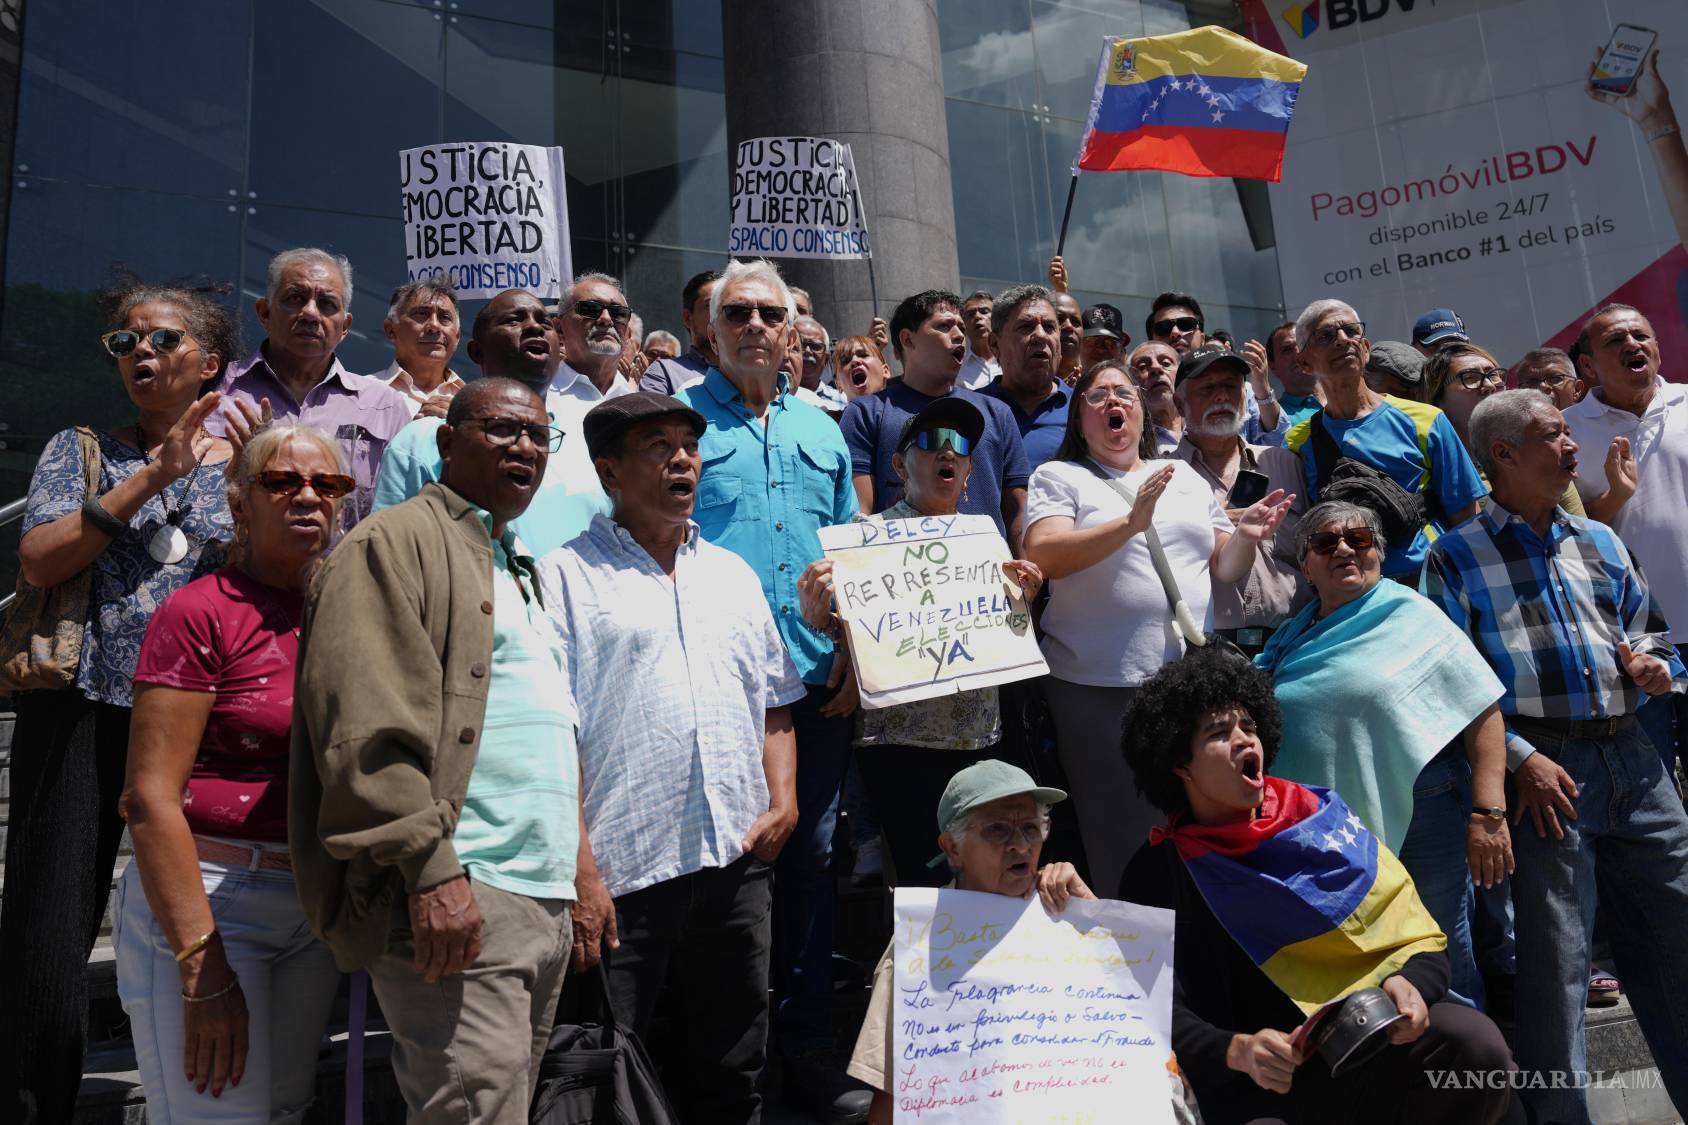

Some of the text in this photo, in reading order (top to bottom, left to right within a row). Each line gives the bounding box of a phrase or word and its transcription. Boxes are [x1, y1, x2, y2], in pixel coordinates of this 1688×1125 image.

[1310, 136, 1597, 221] PagomóvilBDV
[732, 199, 740, 224] Y
[1369, 193, 1550, 245] disponible 24/7
[1324, 215, 1615, 285] con el Banco #1 del país
[449, 262, 541, 290] CONSENSO
[860, 516, 956, 545] DELCY
[903, 541, 949, 566] NO
[843, 560, 1001, 608] REPRESENTA
[920, 589, 935, 605] A
[859, 592, 1011, 643] VENEZUELA
[895, 614, 1028, 657] ELECCIONES
[901, 980, 934, 1009] La
[1065, 1013, 1077, 1023] o
[899, 1063, 923, 1092] Lo
